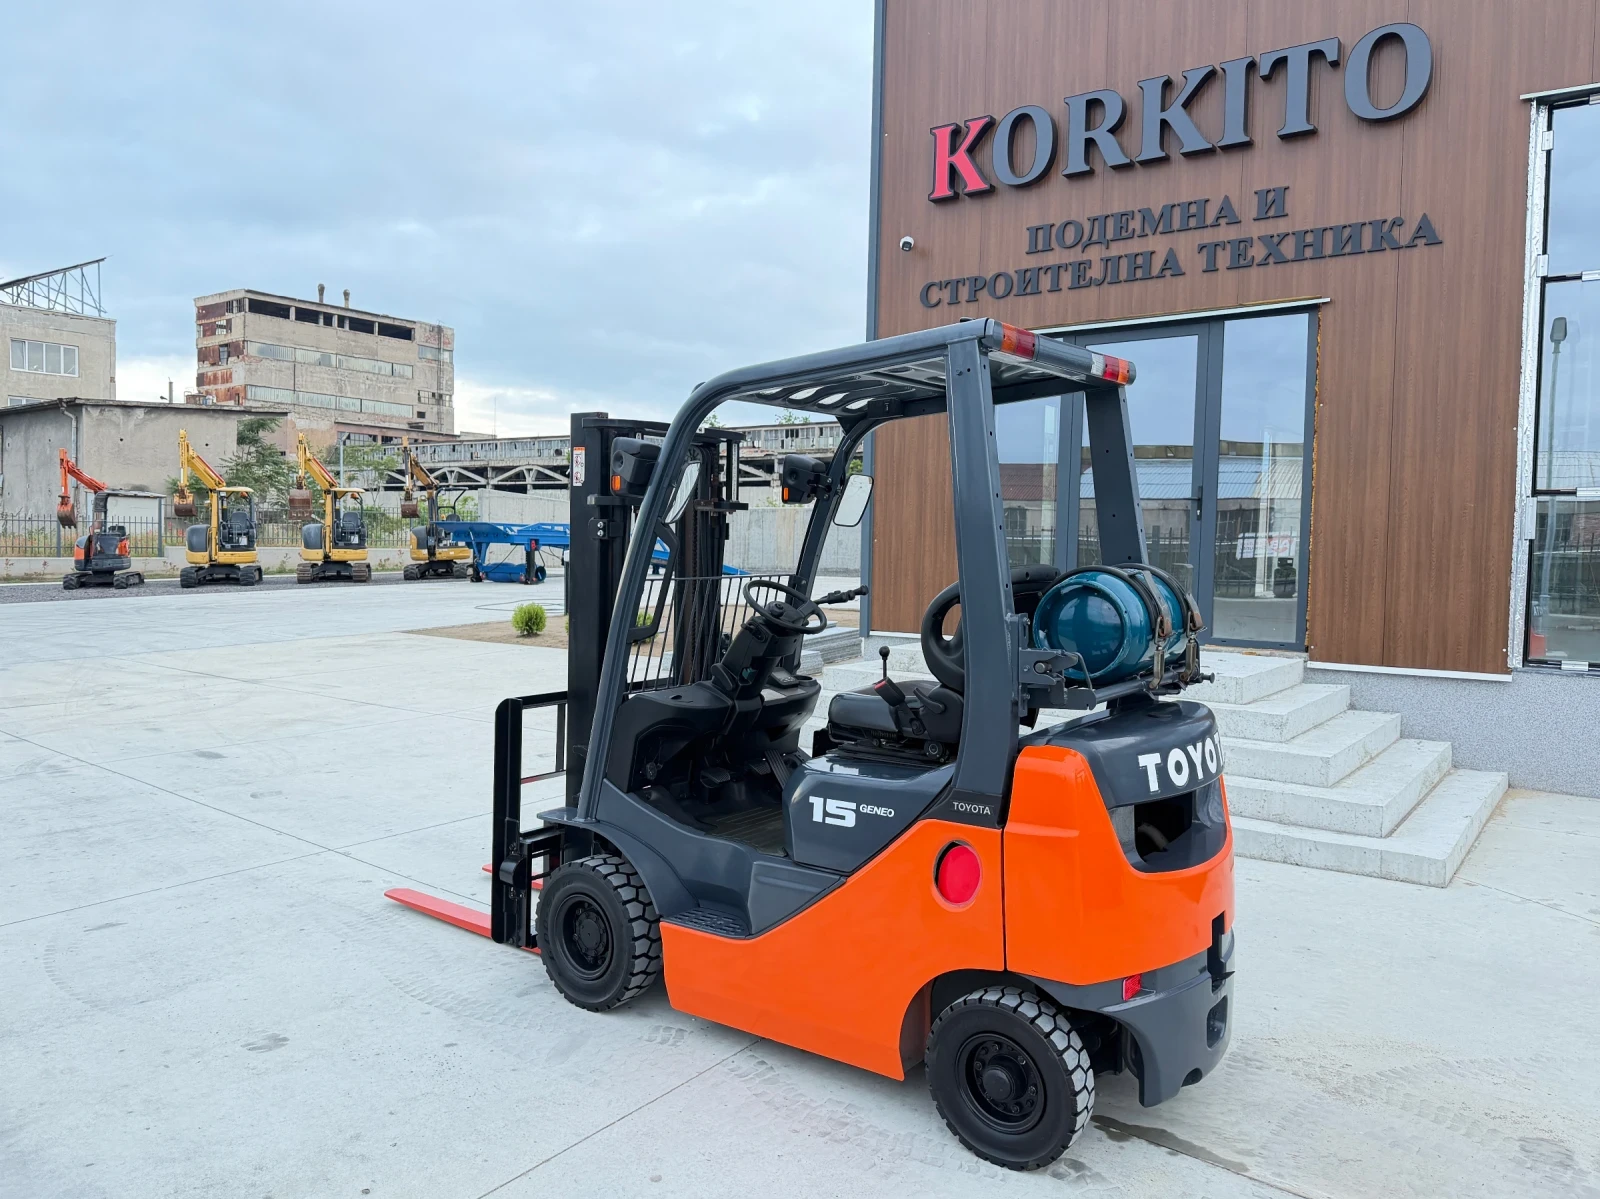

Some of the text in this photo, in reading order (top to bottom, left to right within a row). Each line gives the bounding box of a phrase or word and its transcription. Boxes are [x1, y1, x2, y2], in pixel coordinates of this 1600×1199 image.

[929, 22, 1434, 204] KORKITO
[1026, 185, 1290, 255] ПОДЕМНА И
[919, 212, 1442, 309] СТРОИТЕЛНА ТЕХНИКА
[1138, 731, 1224, 793] TOYOT
[808, 795, 895, 828] 15 GENEO
[952, 801, 992, 815] TOYOTA
